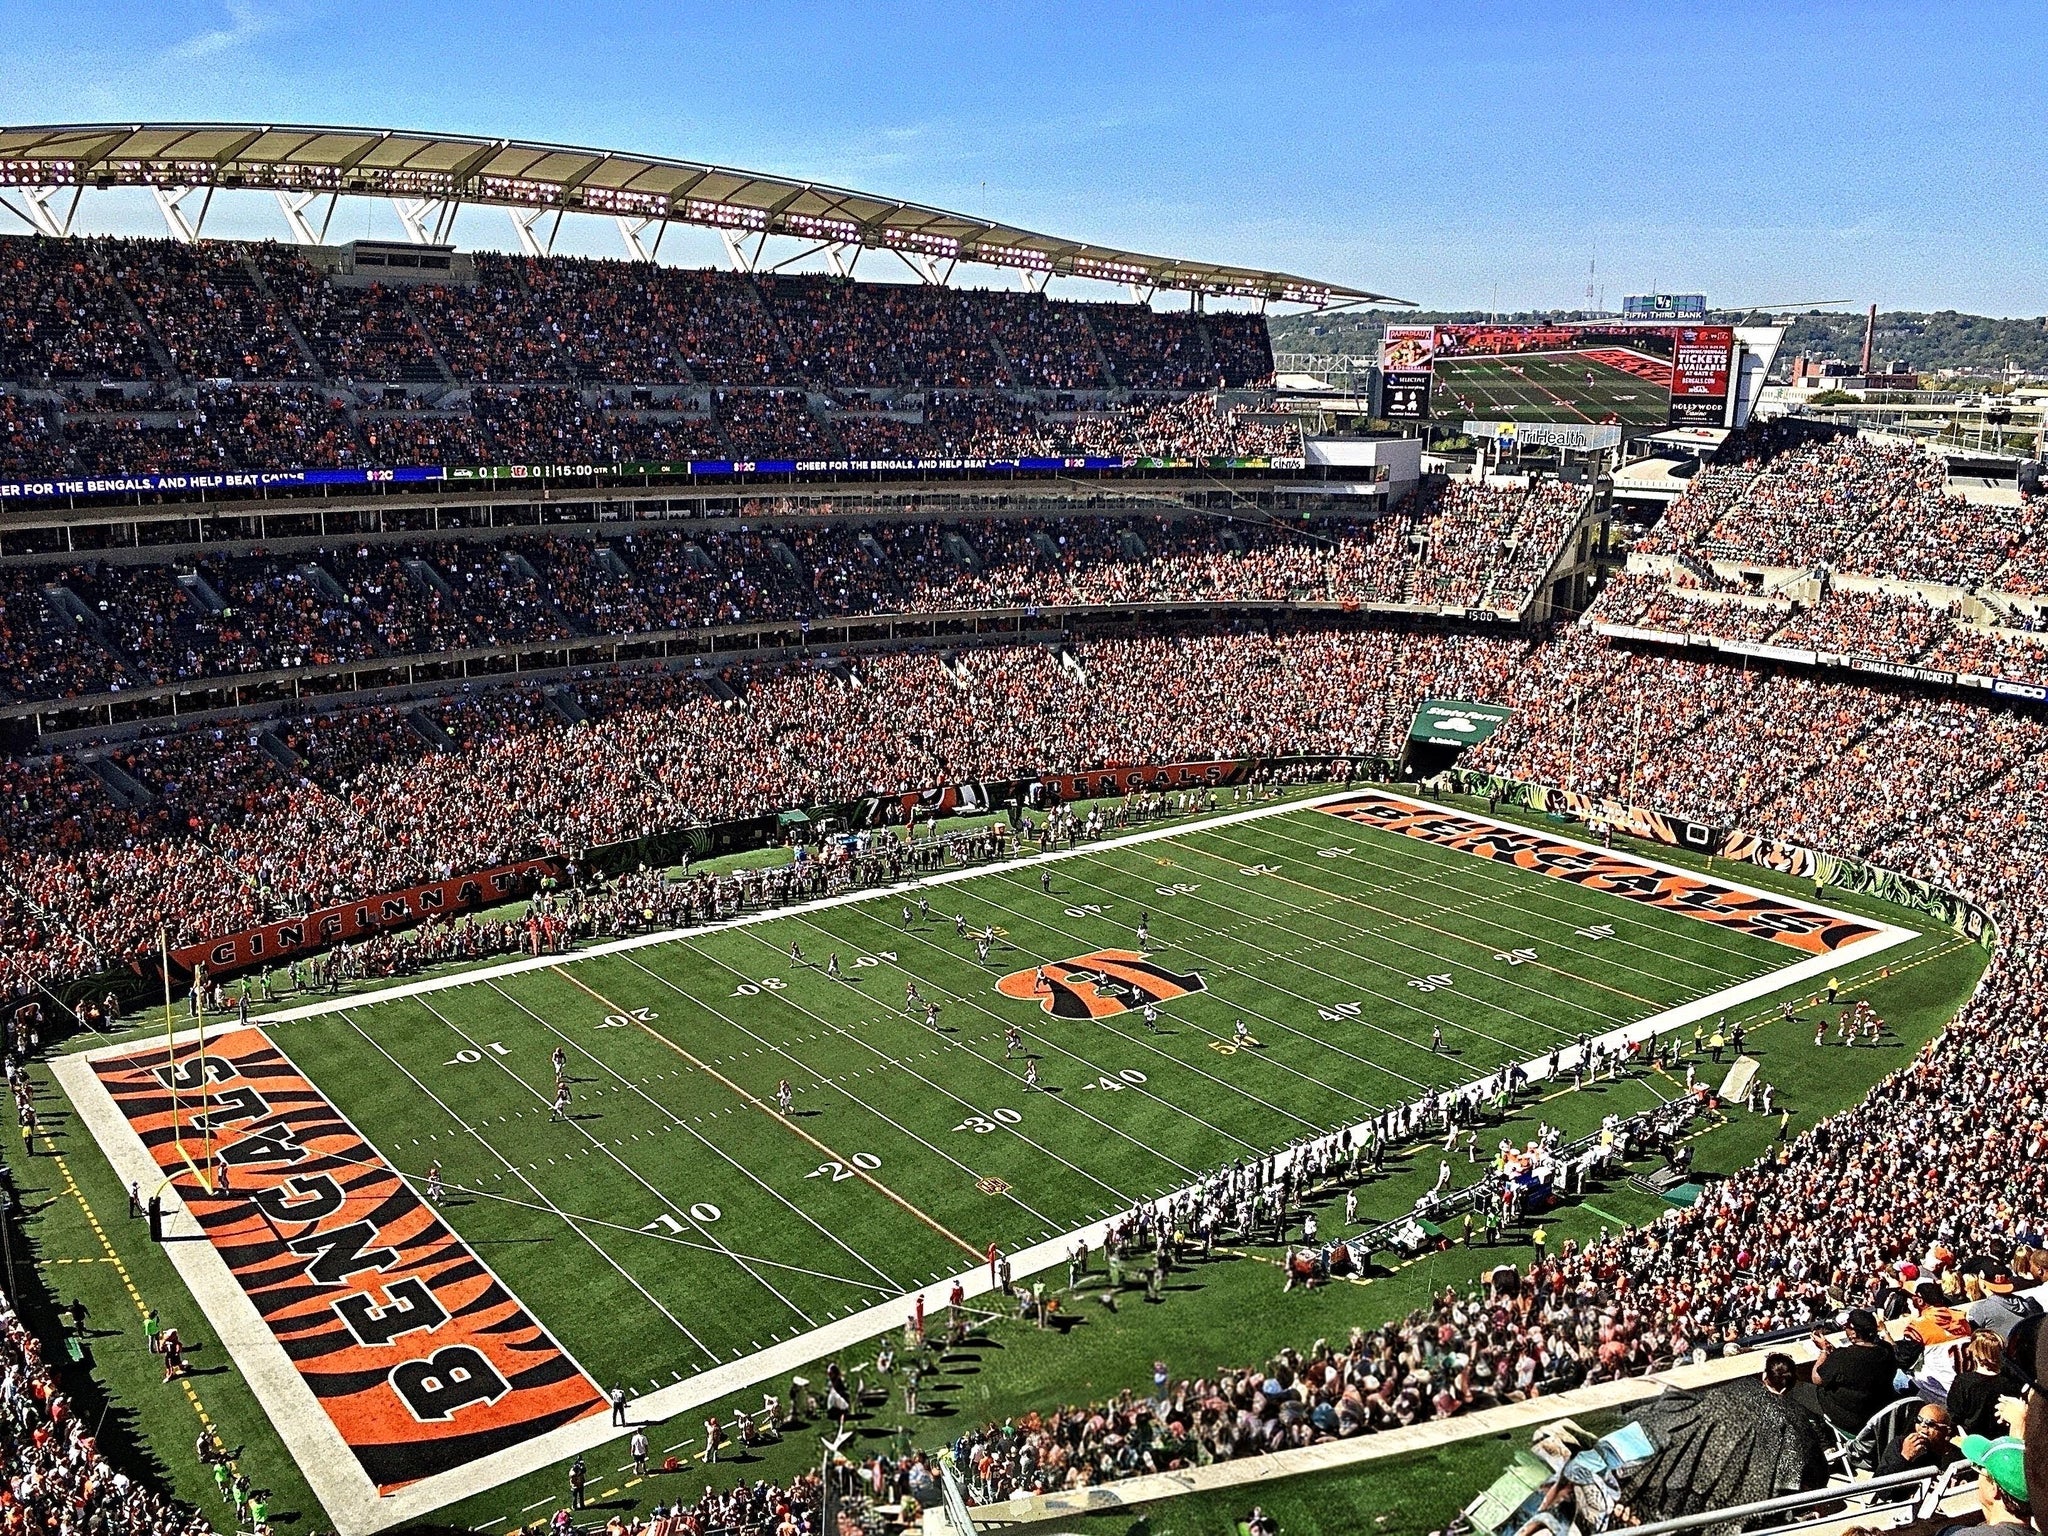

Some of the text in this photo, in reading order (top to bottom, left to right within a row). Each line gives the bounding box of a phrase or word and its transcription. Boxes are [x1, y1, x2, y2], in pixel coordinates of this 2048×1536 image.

[1678, 354, 1727, 364] TICKETS
[1672, 403, 1723, 411] HOLLYWOOD
[1520, 428, 1587, 447] TriHealth
[478, 466, 488, 478] 0
[532, 466, 542, 477] 0
[555, 465, 593, 477] 15:00
[593, 466, 618, 475] QTR 1
[796, 461, 827, 471] CHEER
[829, 461, 848, 470] FOR
[850, 460, 869, 470] THE
[870, 460, 915, 470] BENGALS.
[917, 459, 938, 469] AND
[939, 459, 963, 469] HELP
[964, 458, 987, 468] BEAT
[0, 484, 20, 497] ER
[24, 483, 54, 495] FOR
[55, 481, 84, 494] THE
[87, 478, 155, 492] BENGALS.
[158, 477, 187, 489] AND
[190, 476, 224, 488] HELP
[225, 474, 259, 486] BEAT
[1468, 611, 1493, 622] 15:00
[1851, 658, 1954, 685] BENGALS.COM/TICKETS
[1994, 681, 2047, 700] GEICO
[1045, 765, 1222, 798] BENGALS
[1353, 802, 1825, 937] BENGALS
[1155, 881, 1197, 897] 30
[1575, 924, 1616, 941] 10
[855, 949, 899, 969] 40
[1494, 948, 1538, 967] 20
[736, 976, 788, 998] 30
[1407, 974, 1453, 993] 30
[603, 1006, 660, 1029] 20
[1317, 1003, 1363, 1023] 40
[456, 1040, 514, 1066] 10
[1208, 1034, 1261, 1056] 50
[1097, 1068, 1148, 1092] 40
[963, 1107, 1023, 1134] 30
[818, 1152, 883, 1183] 20
[653, 1202, 723, 1236] 10
[152, 1054, 513, 1425] BENGALS
